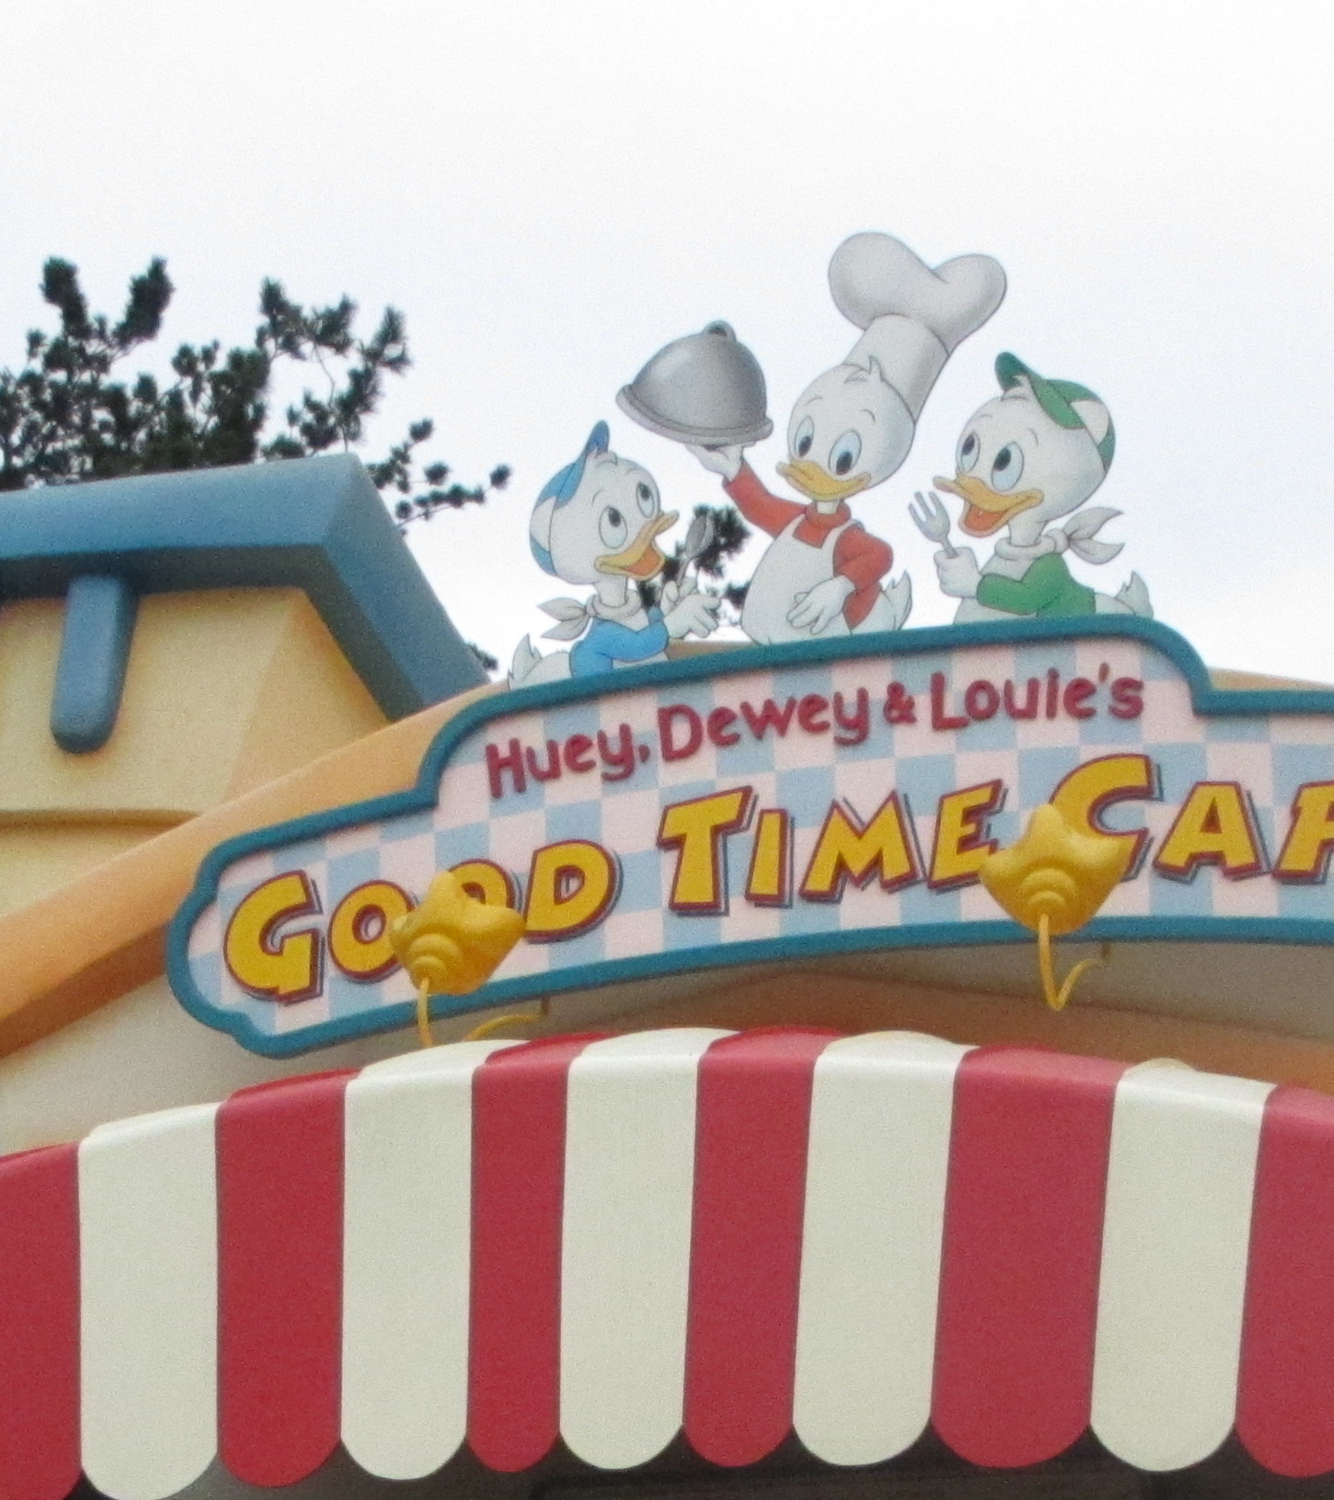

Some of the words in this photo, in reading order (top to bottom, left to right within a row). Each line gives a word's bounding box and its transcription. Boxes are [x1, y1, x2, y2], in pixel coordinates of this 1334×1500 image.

[657, 686, 870, 762] Dewey
[882, 681, 918, 725] &
[929, 662, 1145, 731] Louie's
[656, 778, 1009, 917] TIME
